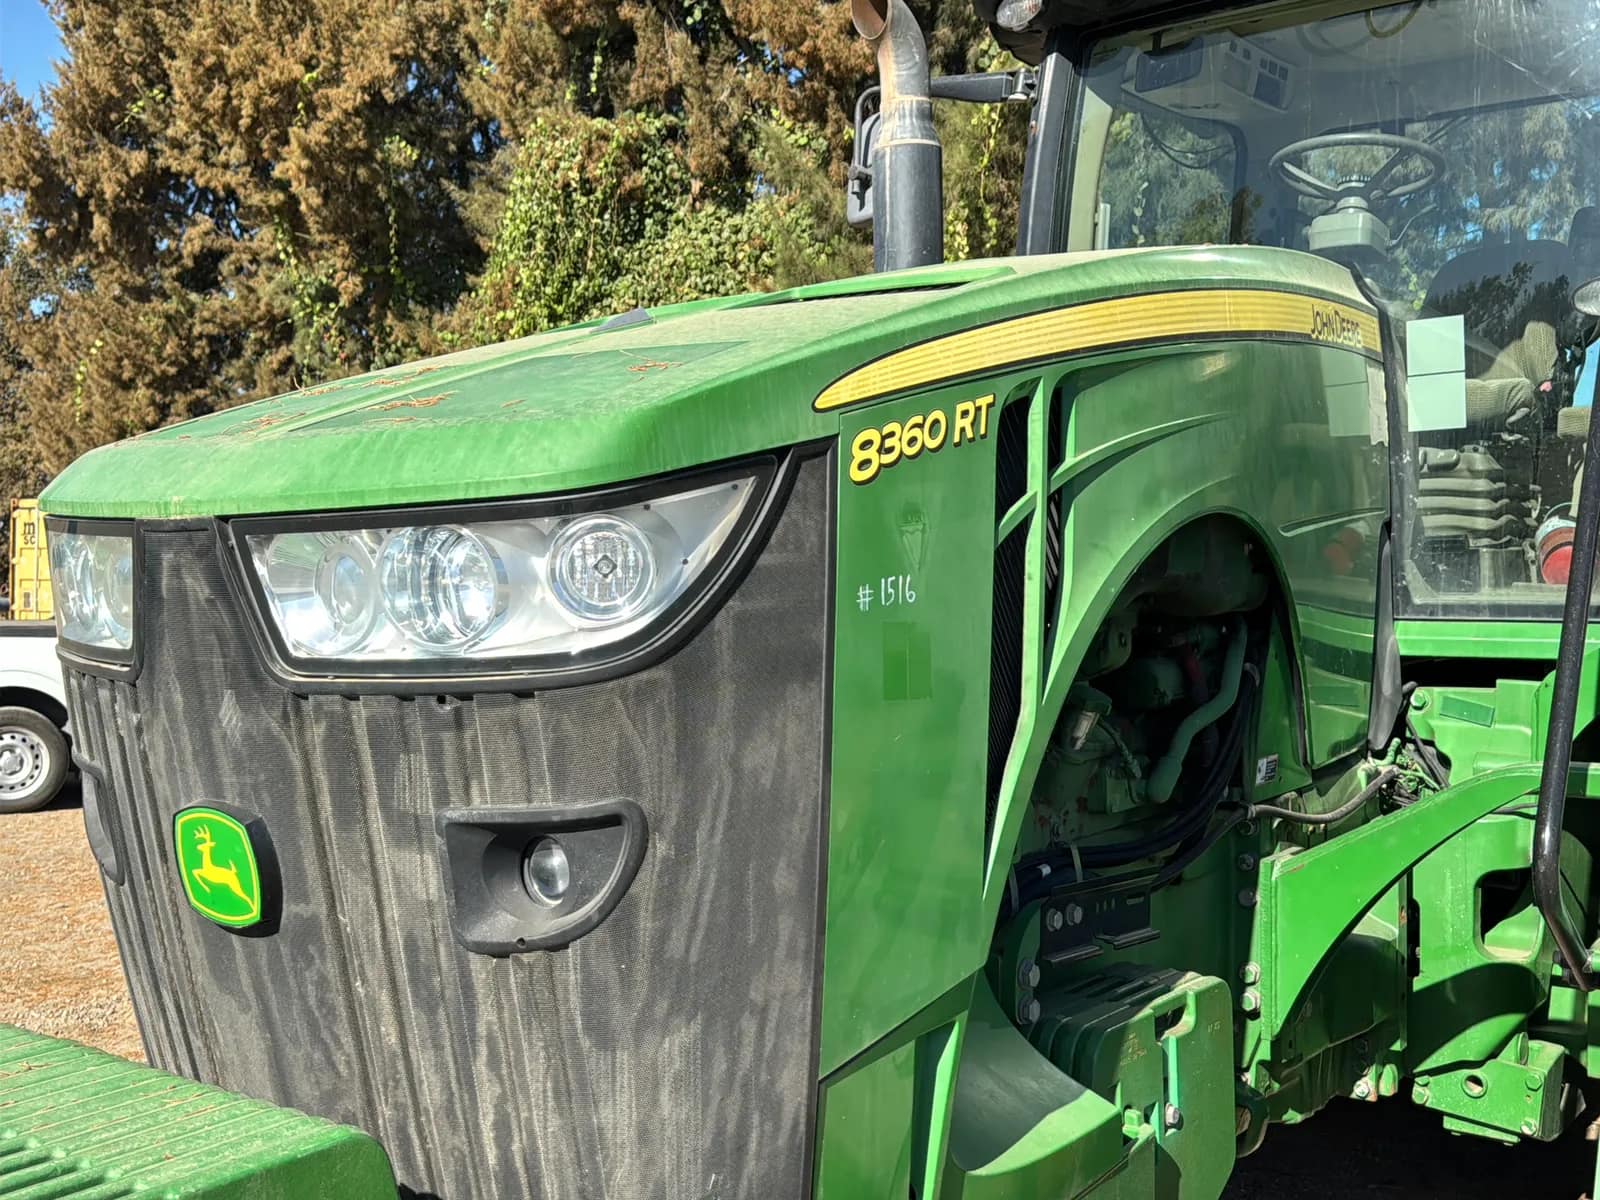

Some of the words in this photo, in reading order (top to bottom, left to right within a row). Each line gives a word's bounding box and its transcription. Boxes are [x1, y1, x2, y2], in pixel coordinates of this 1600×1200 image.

[1310, 303, 1334, 341] JOHN
[1334, 309, 1362, 348] DEERE
[849, 409, 947, 485] 8360
[953, 393, 995, 446] RT
[880, 574, 917, 606] 1516
